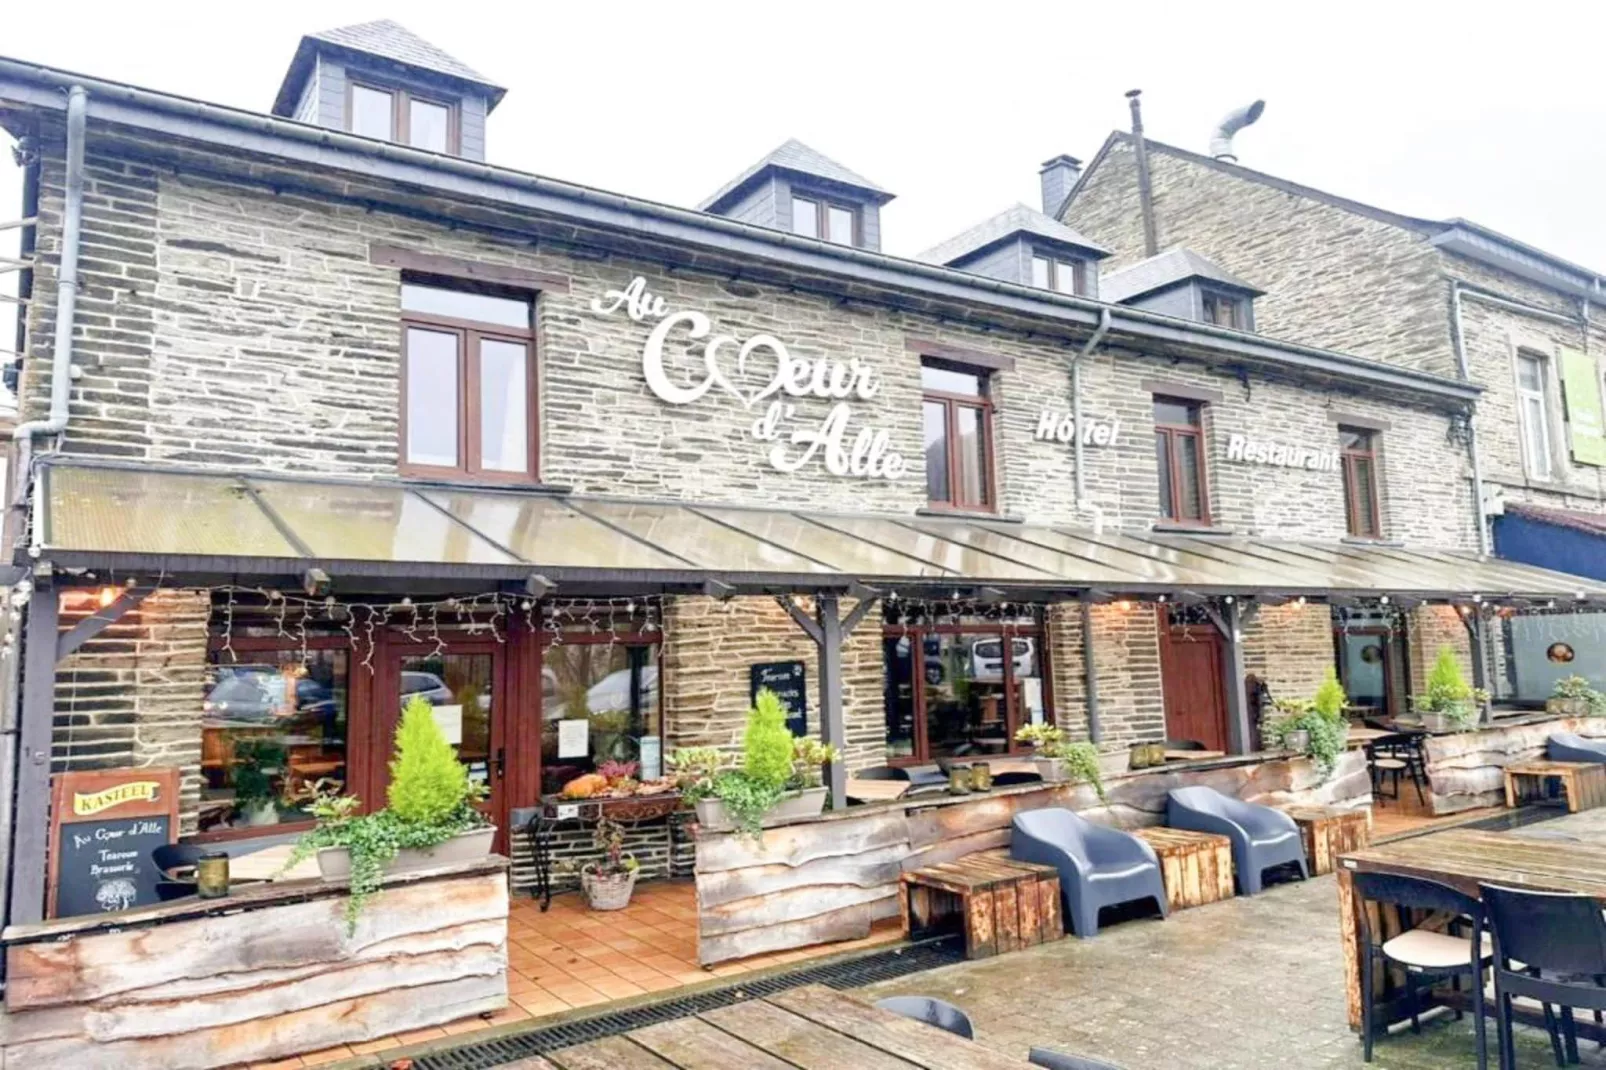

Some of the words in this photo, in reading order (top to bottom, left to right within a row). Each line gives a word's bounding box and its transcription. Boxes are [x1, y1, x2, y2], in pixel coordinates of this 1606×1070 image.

[591, 276, 670, 320] Au
[1226, 433, 1342, 470] Restaurant
[81, 784, 151, 811] KASTEEL
